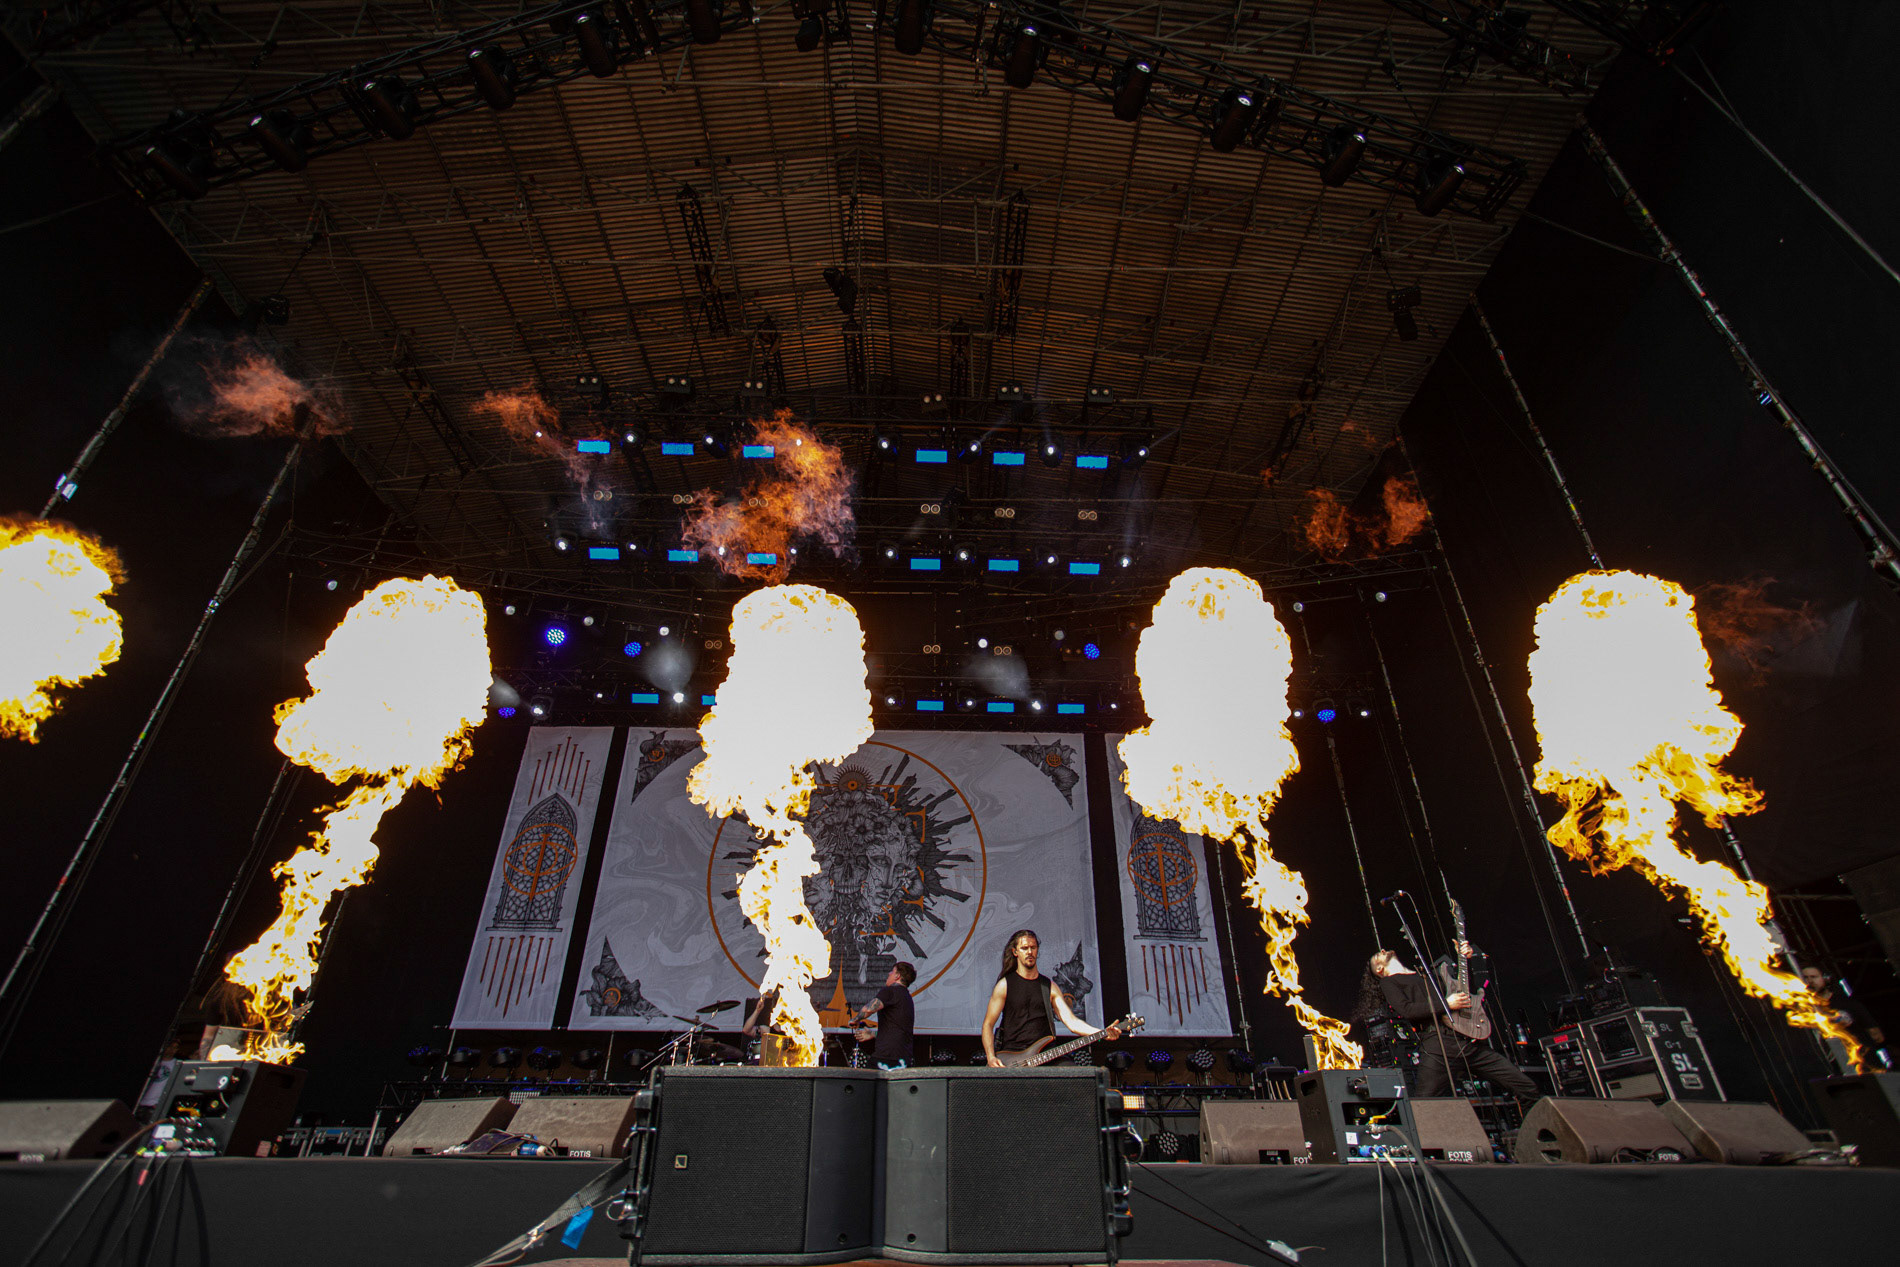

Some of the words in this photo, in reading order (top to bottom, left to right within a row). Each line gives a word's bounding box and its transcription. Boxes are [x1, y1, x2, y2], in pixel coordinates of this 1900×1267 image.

[1660, 1023, 1673, 1032] SL
[1671, 1053, 1699, 1072] SL
[218, 1075, 229, 1090] 9
[1393, 1085, 1402, 1098] 7
[569, 1150, 591, 1158] FOTIS
[1447, 1151, 1473, 1159] FOTIS
[1657, 1153, 1680, 1161] FOTIS
[1293, 1156, 1309, 1164] FOT
